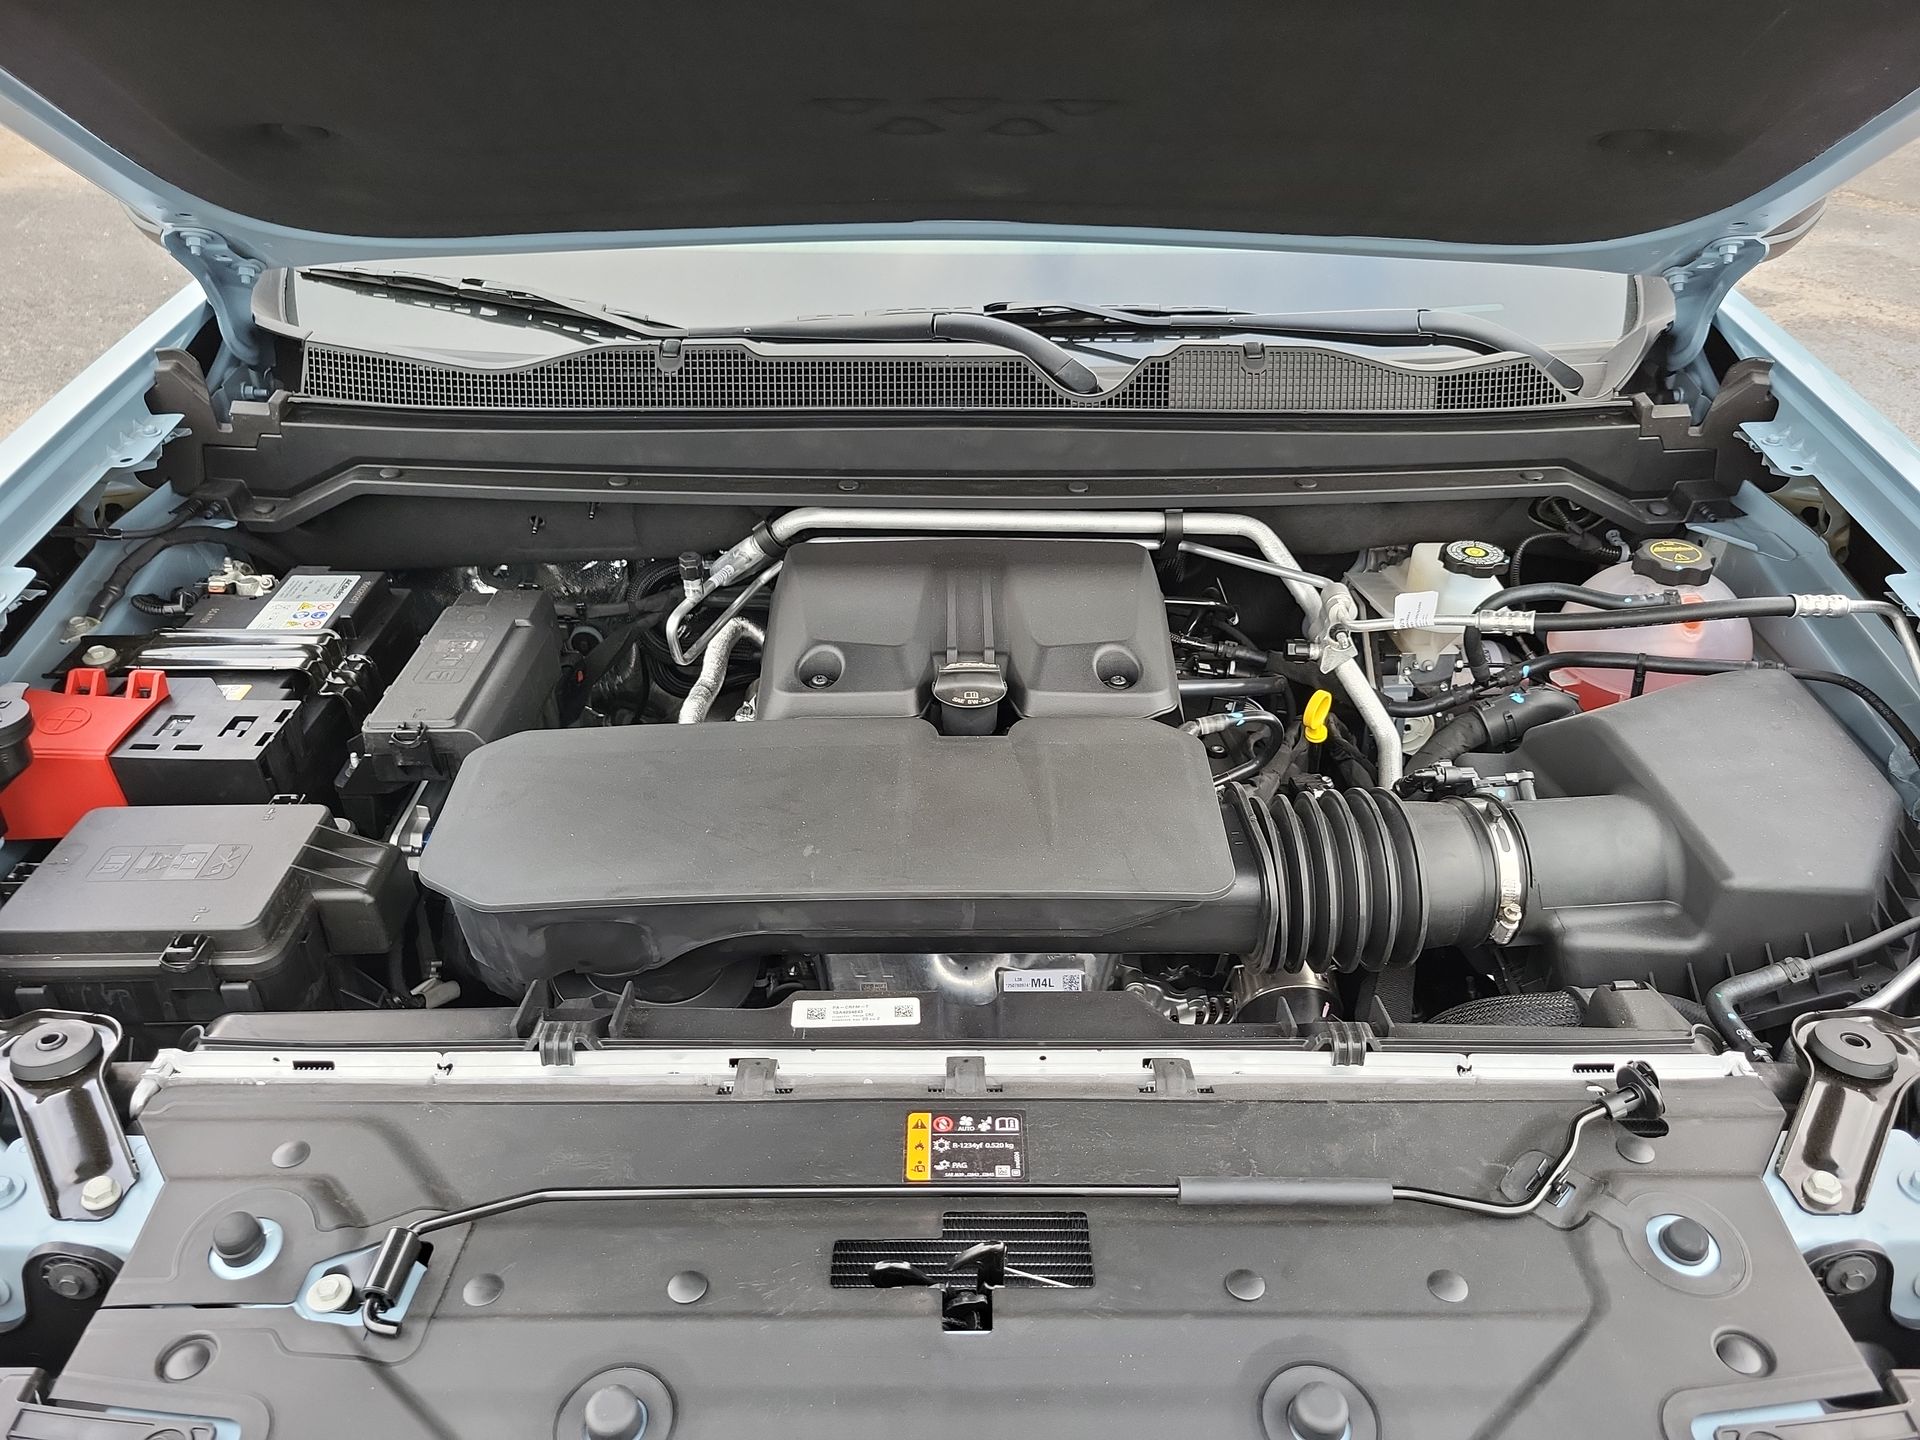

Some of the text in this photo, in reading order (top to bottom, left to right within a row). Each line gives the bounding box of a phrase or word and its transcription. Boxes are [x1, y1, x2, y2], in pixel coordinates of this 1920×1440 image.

[333, 578, 353, 599] ACDelco
[1031, 978, 1054, 988] M4L
[1004, 1142, 1014, 1150] kg
